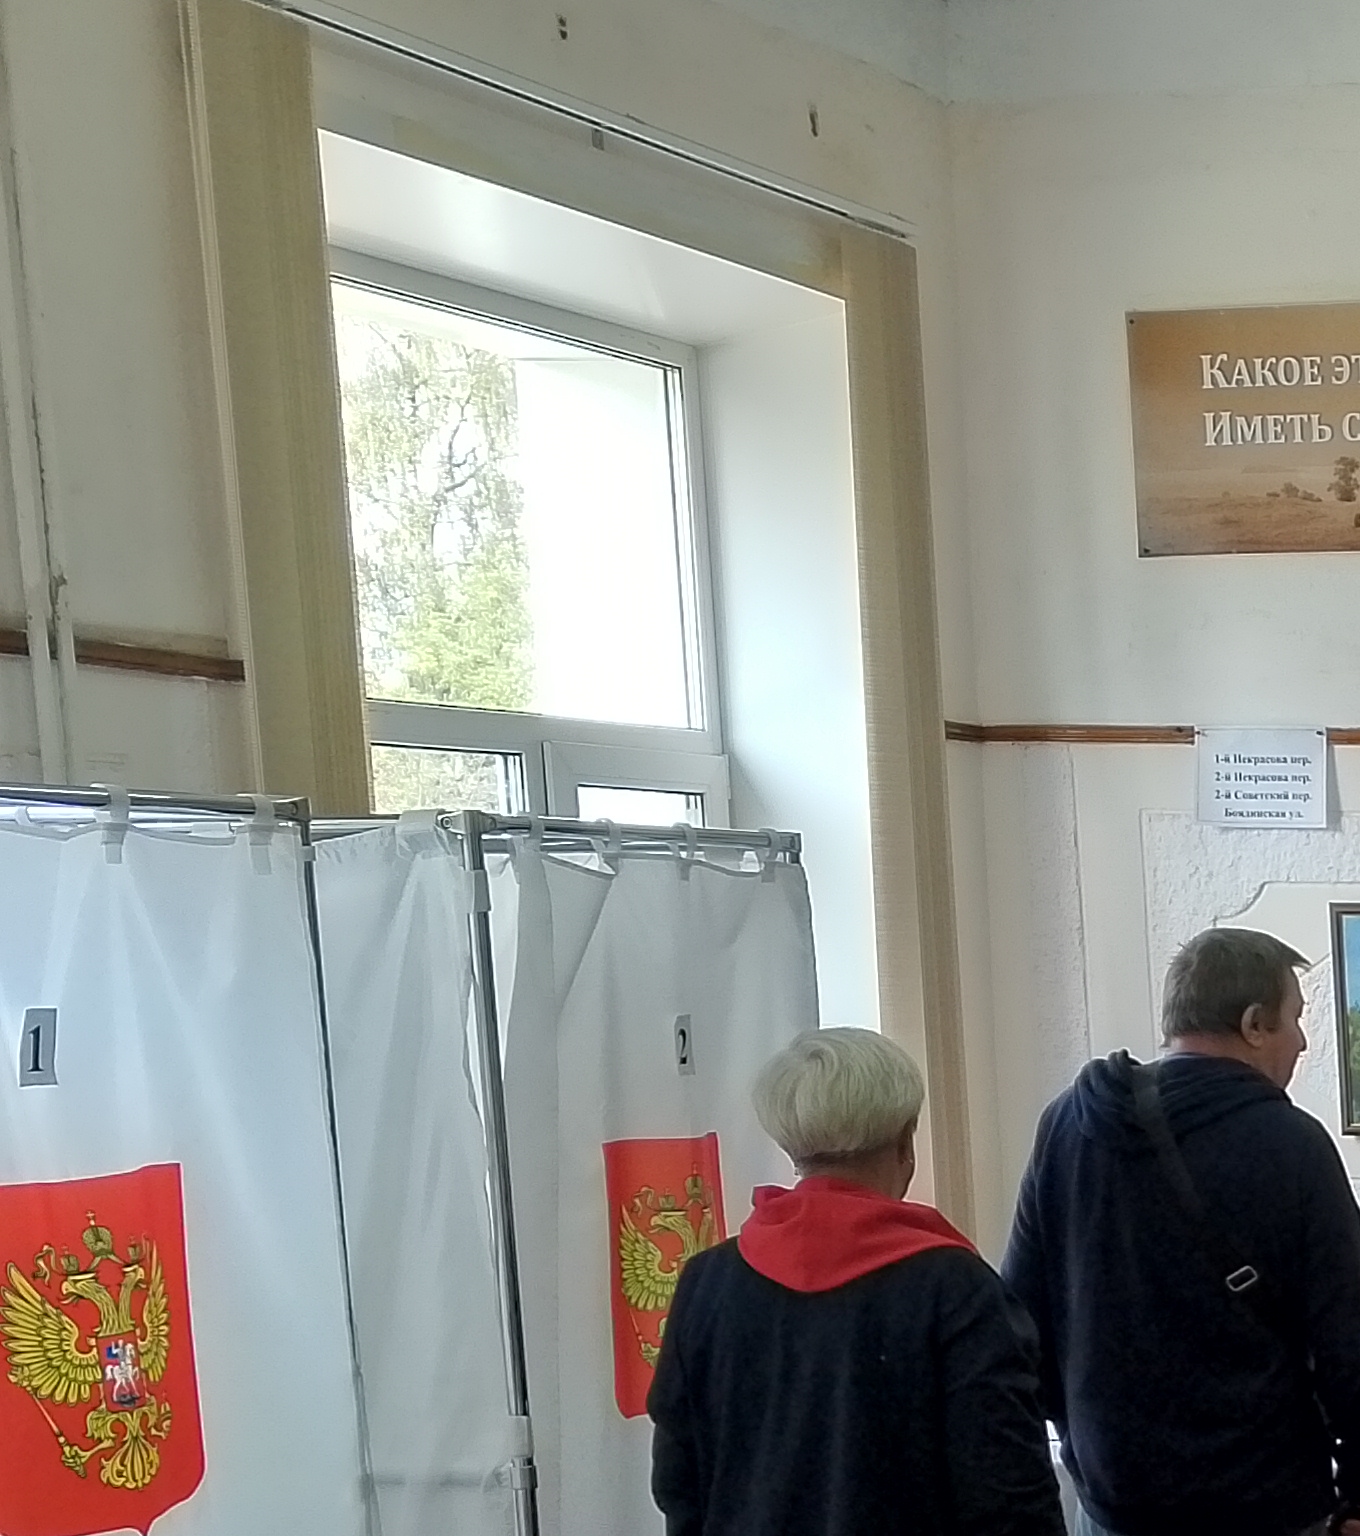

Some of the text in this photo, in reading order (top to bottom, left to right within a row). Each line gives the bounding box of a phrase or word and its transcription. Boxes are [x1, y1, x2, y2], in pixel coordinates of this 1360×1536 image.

[1233, 753, 1288, 766] Некрасова
[1234, 771, 1289, 786] Некрасова
[1233, 789, 1289, 801] Советский
[27, 1025, 45, 1072] 1
[677, 1028, 688, 1065] 2
